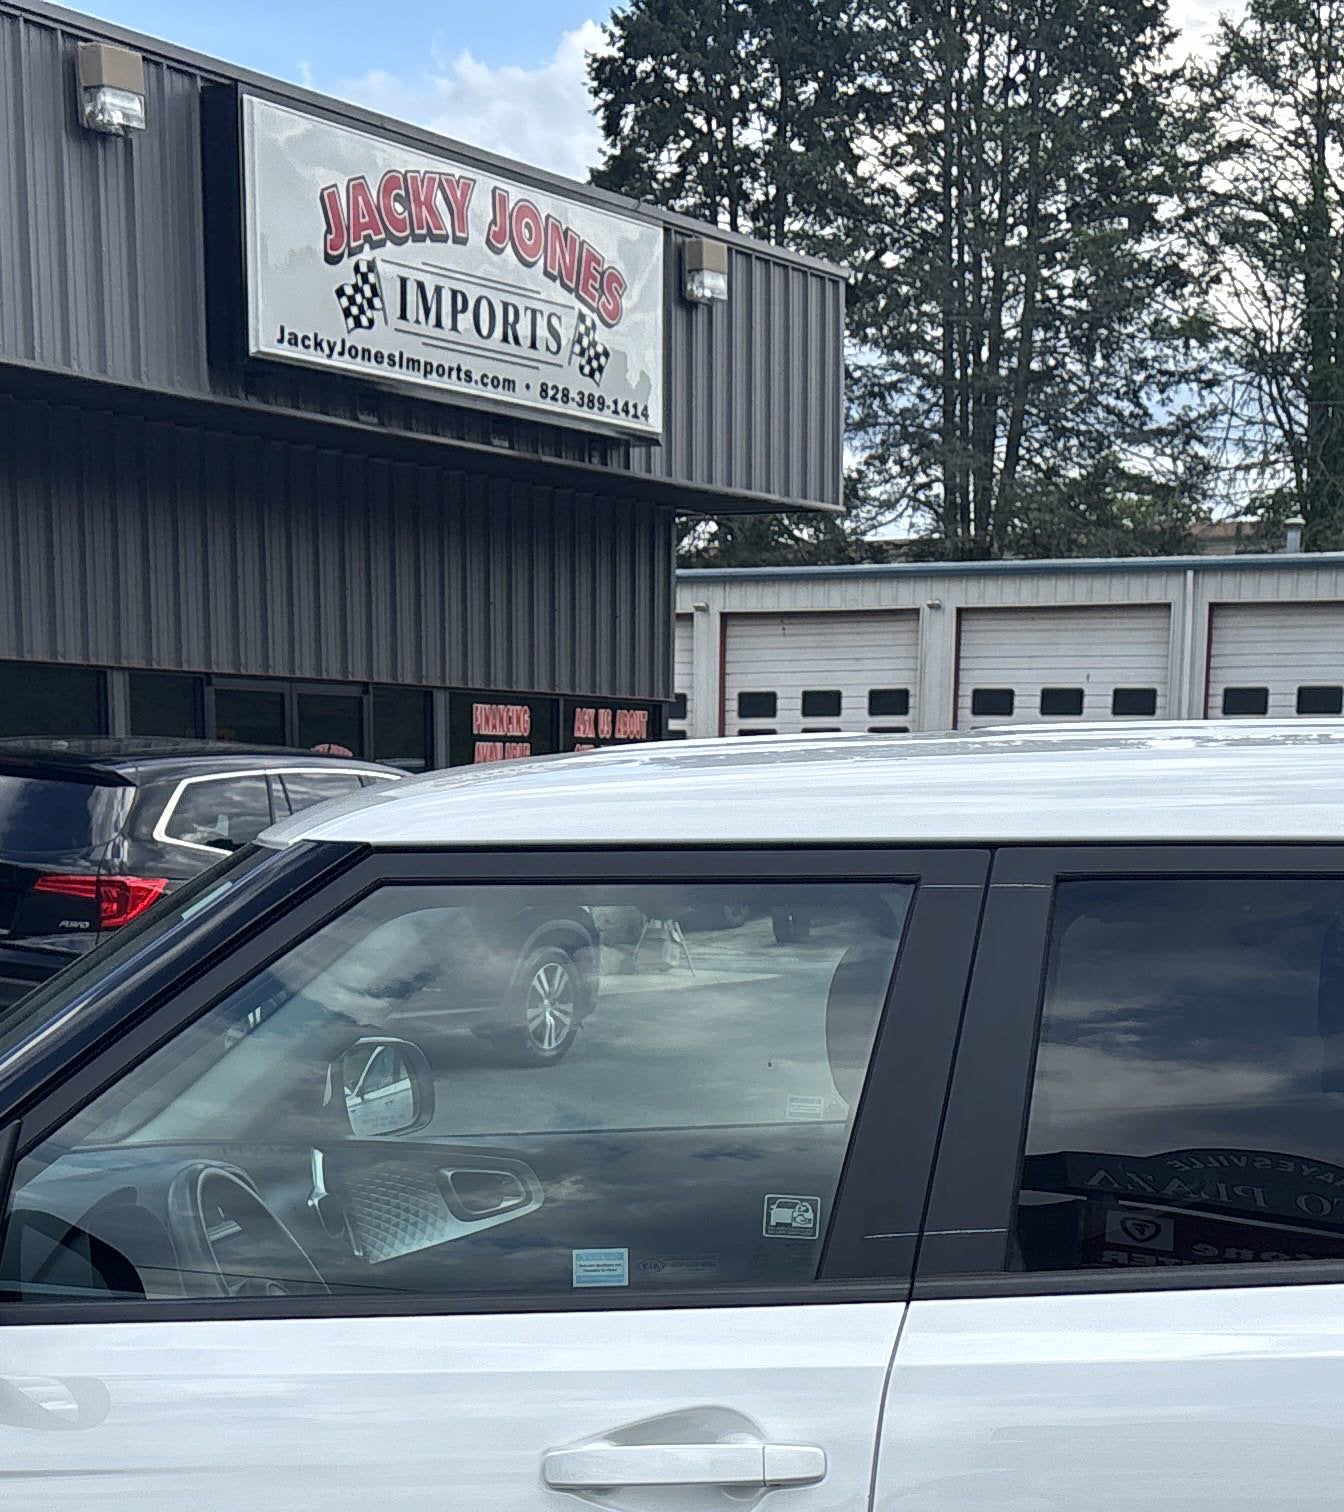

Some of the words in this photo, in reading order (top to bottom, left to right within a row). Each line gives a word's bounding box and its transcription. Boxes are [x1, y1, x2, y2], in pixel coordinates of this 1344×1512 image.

[319, 170, 476, 264] JACKY
[485, 186, 628, 328] JONES
[395, 275, 563, 356] IMPORTS
[276, 325, 517, 393] JackyJonesImports.com
[538, 381, 650, 421] 828-389-1414
[472, 703, 530, 736] FINANCING
[574, 708, 595, 738] ASK
[598, 708, 612, 739] US
[615, 710, 648, 739] ABOUT
[58, 920, 90, 929] AWD
